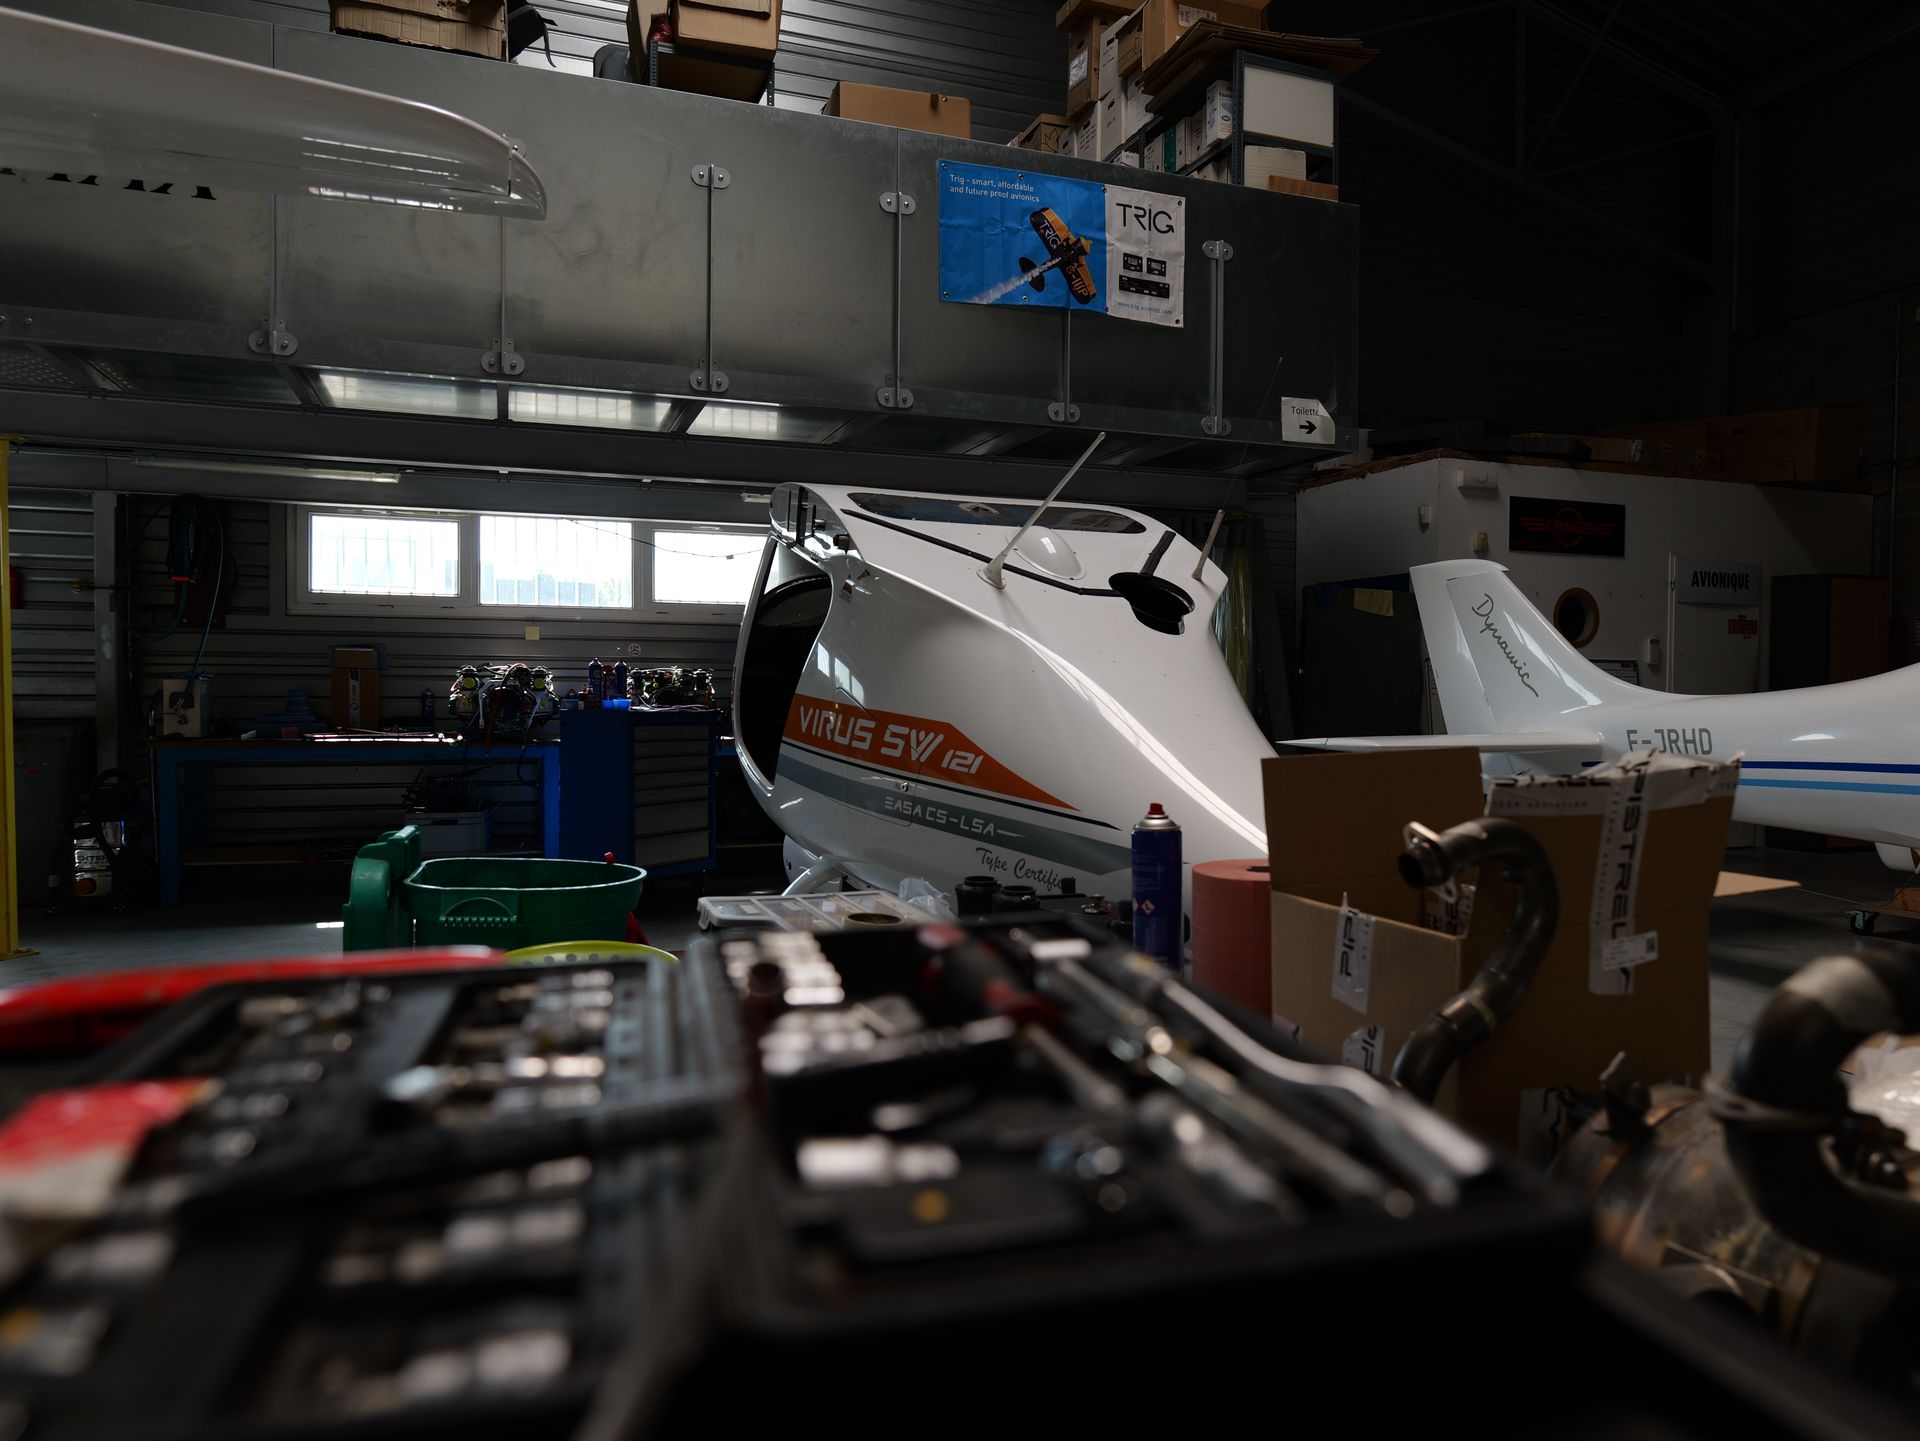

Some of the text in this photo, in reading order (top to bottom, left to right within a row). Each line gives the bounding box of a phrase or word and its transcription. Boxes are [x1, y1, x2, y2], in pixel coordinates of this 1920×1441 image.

[950, 174, 965, 185] Trig
[971, 177, 997, 188] smart,
[997, 180, 1035, 193] affordable
[950, 186, 1041, 203] and future proof avionics
[1116, 203, 1174, 234] TRIG
[1039, 218, 1064, 251] TRIG
[1691, 571, 1750, 592] AVIONIQUE
[1471, 593, 1539, 698] Dynamic
[800, 704, 984, 774] VIRUS SW 121
[1626, 728, 1713, 755] F-JRHD
[884, 796, 995, 837] EASA CS-LSA
[975, 847, 1008, 872] Type
